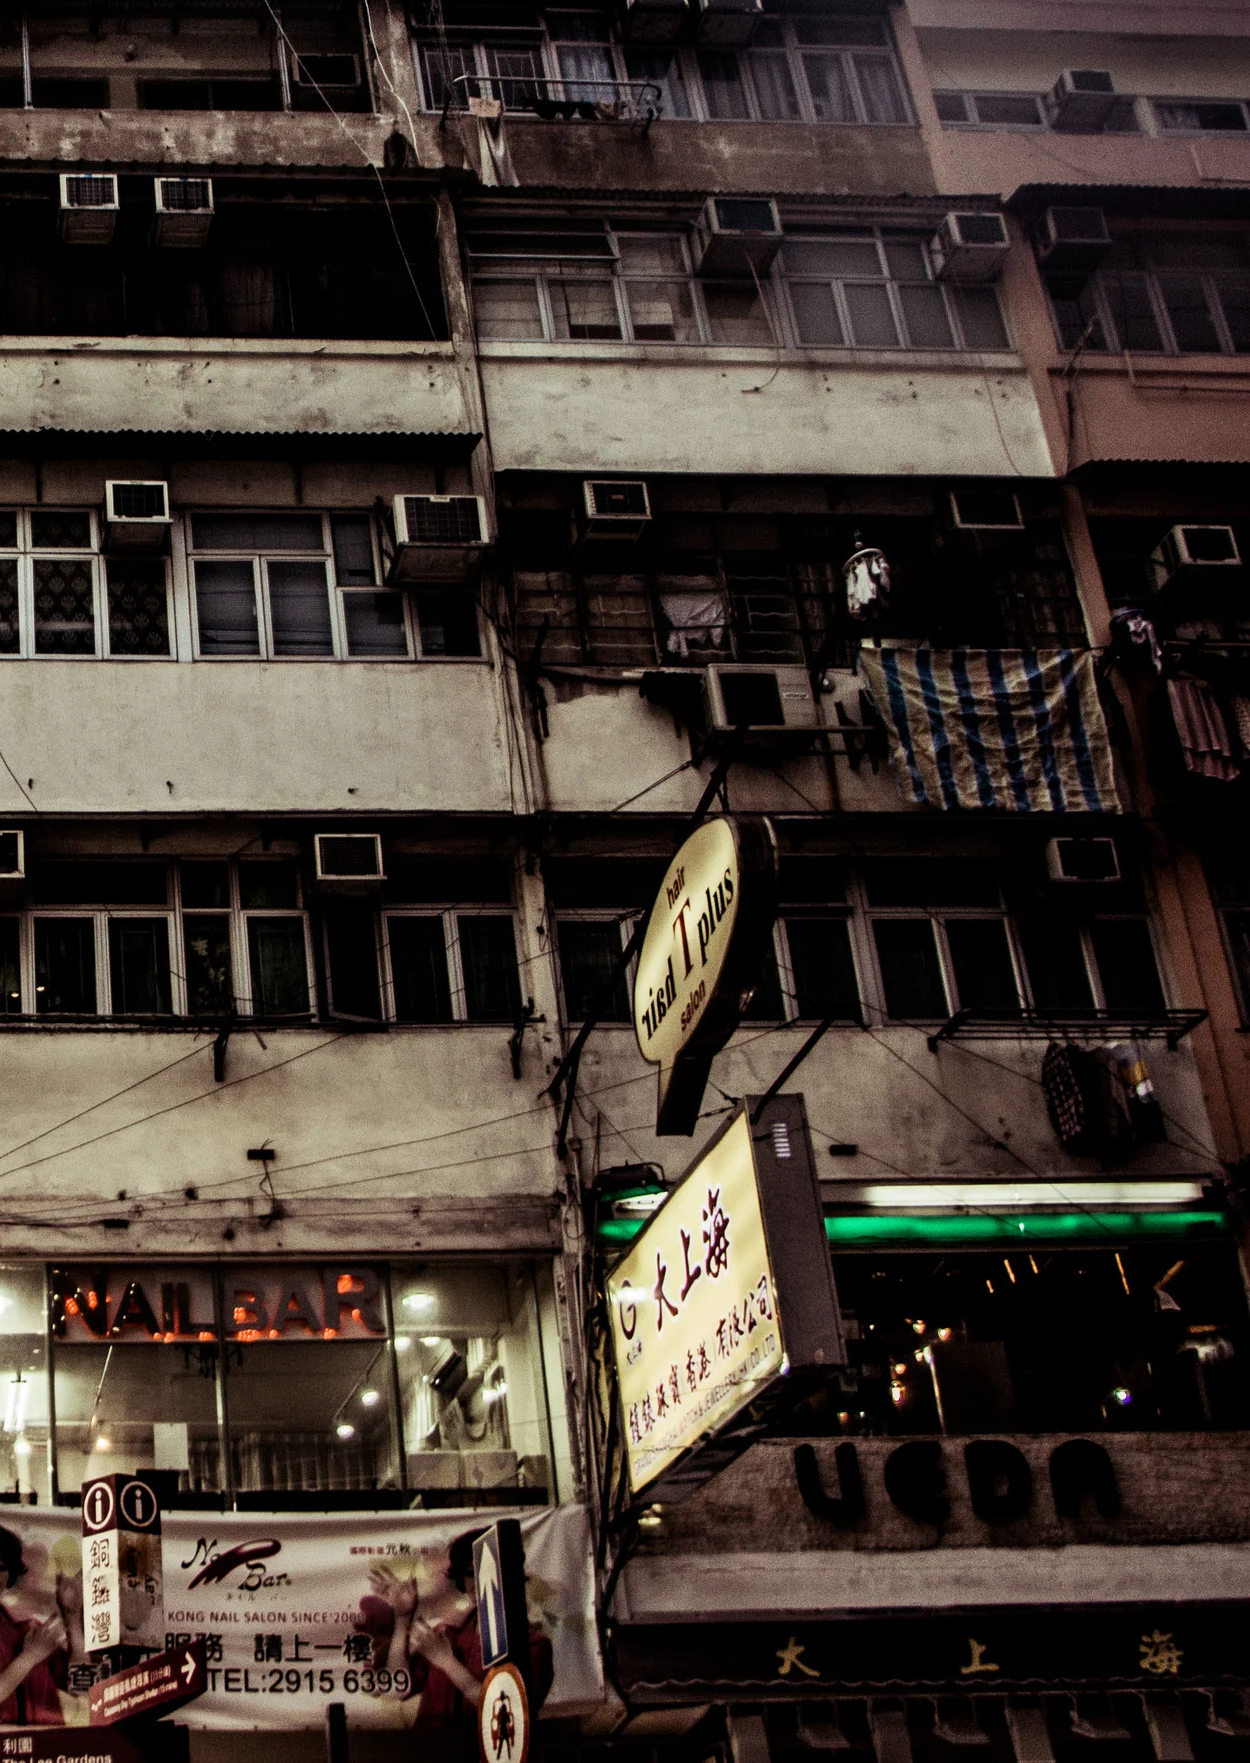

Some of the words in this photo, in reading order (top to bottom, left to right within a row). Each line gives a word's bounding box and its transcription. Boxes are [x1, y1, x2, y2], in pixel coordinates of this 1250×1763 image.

[666, 865, 686, 909] hair
[673, 897, 695, 981] T
[697, 866, 734, 968] plus
[680, 979, 706, 1032] salon
[654, 1188, 731, 1333] 大上海
[51, 1264, 216, 1341] NAIL
[232, 1266, 388, 1340] BAR
[167, 1610, 204, 1624] KONG
[209, 1610, 239, 1623] NAIL
[243, 1610, 287, 1624] SALON
[776, 1629, 1184, 1678] 大上海
[343, 1668, 411, 1693] 6399
